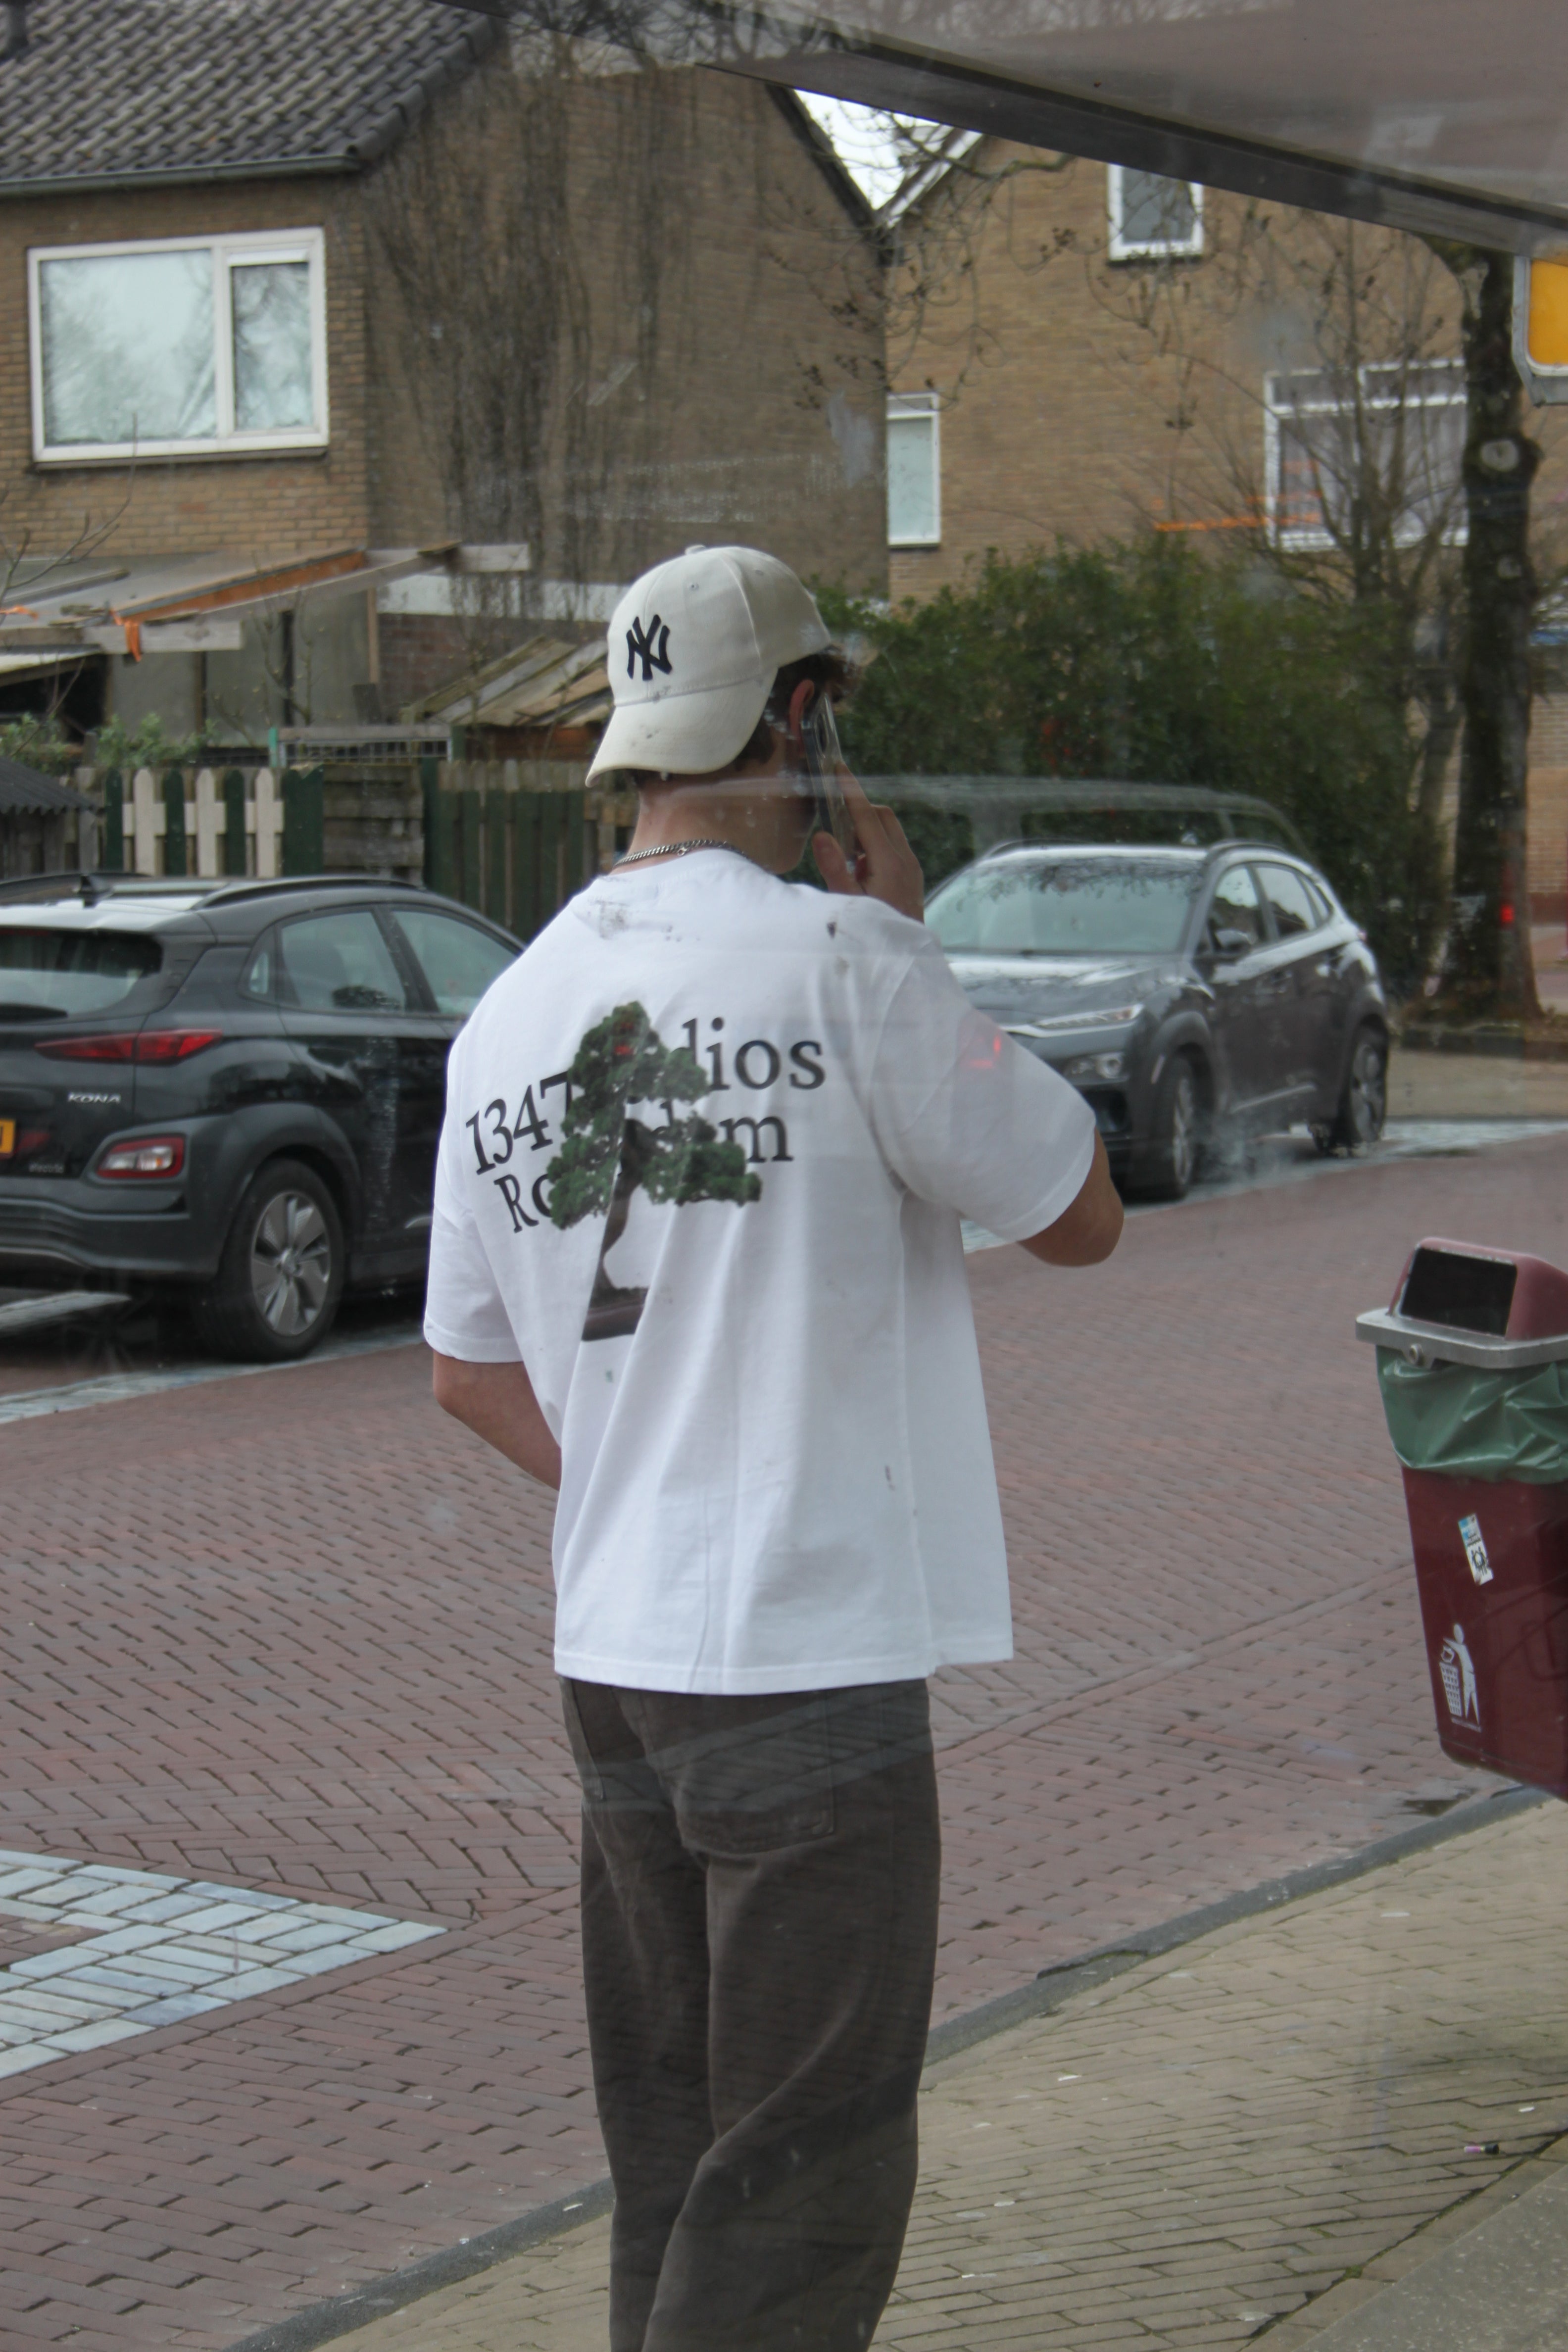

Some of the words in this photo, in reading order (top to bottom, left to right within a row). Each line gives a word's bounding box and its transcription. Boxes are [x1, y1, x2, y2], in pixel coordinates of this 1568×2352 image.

[626, 614, 673, 681] NY
[68, 1092, 122, 1104] KONA
[465, 1071, 573, 1176] 1347
